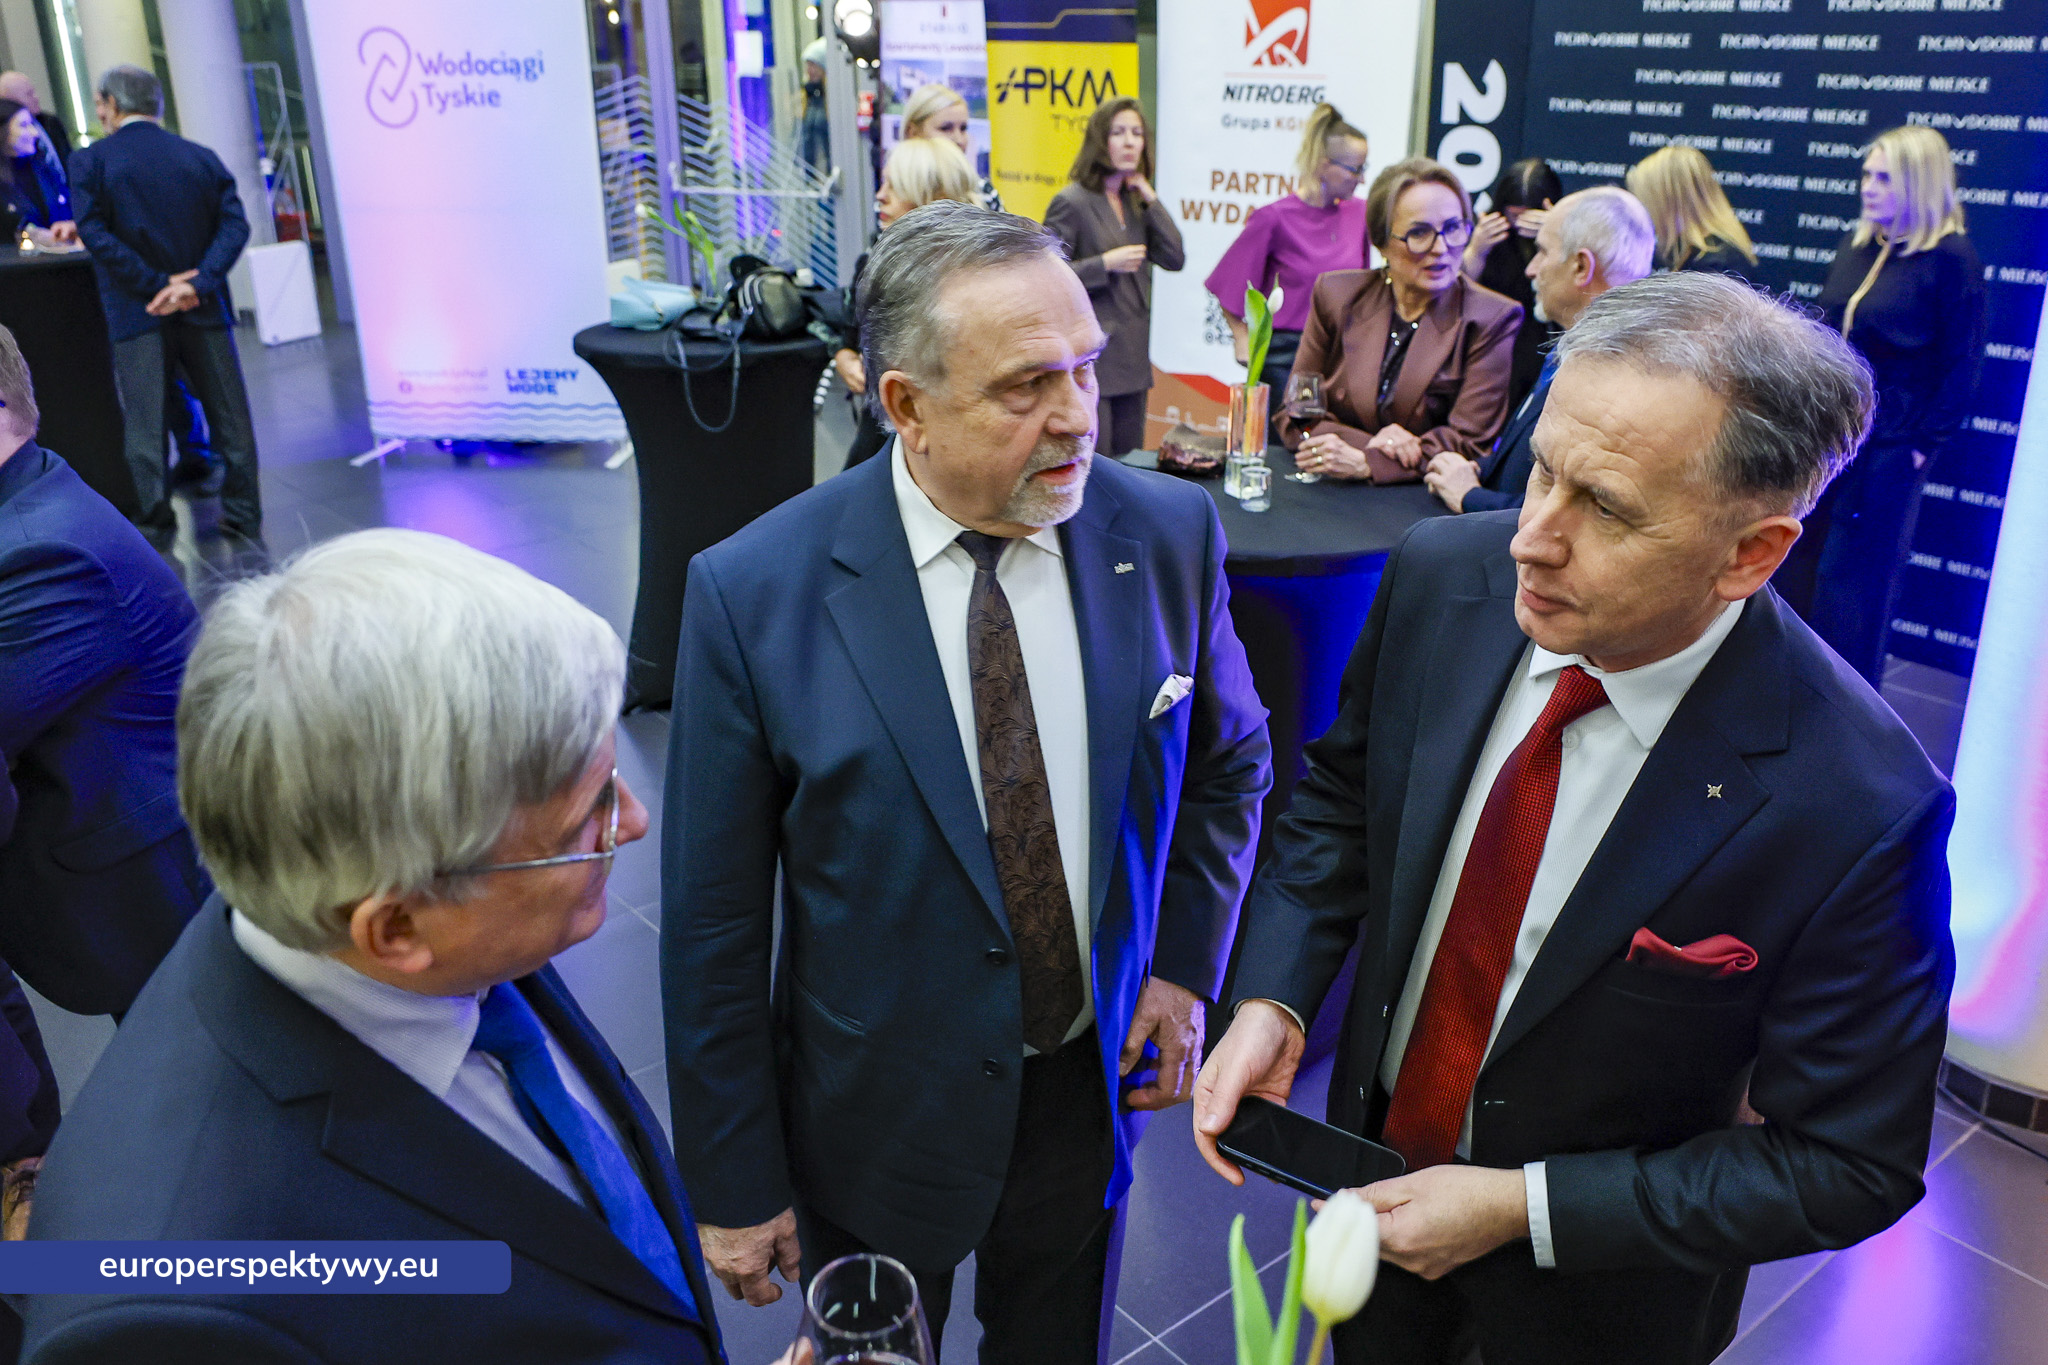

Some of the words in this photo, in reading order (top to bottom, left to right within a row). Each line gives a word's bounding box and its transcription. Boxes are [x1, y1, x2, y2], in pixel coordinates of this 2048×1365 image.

[416, 50, 545, 82] Wodociągi
[421, 82, 502, 114] Tyskie
[1023, 67, 1117, 107] PKM
[1223, 84, 1327, 104] NITROERG
[1050, 113, 1090, 132] TYC
[1221, 114, 1270, 131] Grupa
[1436, 58, 1507, 217] 20
[1210, 169, 1301, 196] PARTN
[1180, 199, 1255, 225] WYDA
[504, 368, 579, 381] LEJEMY
